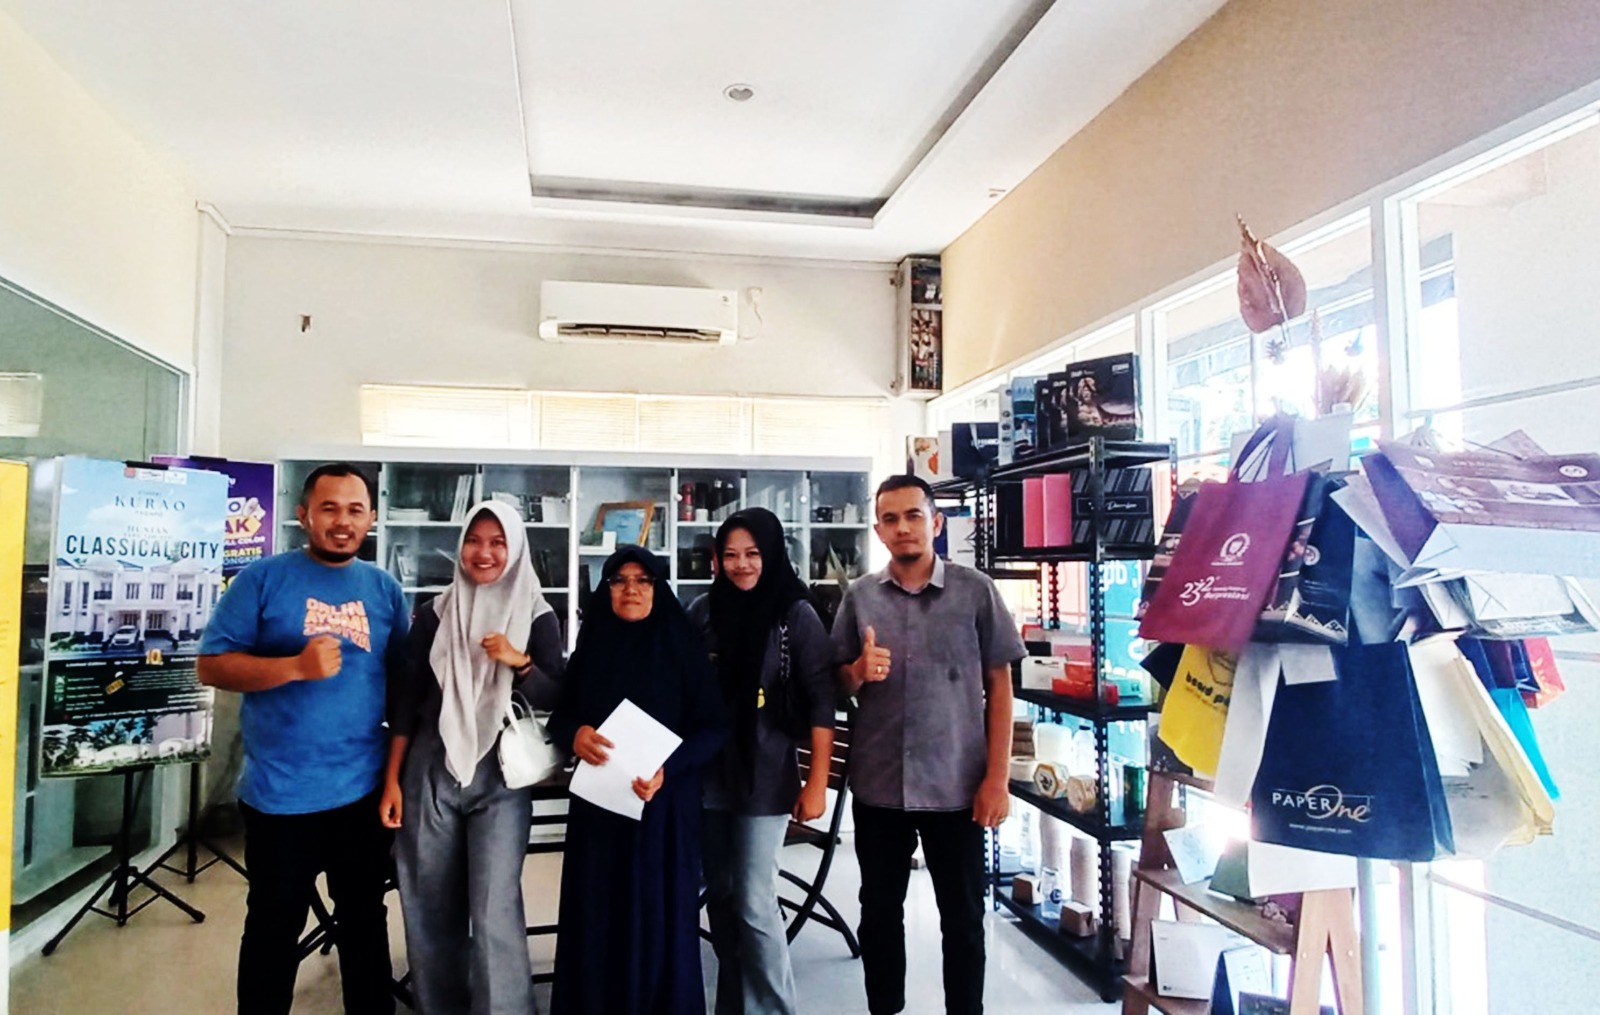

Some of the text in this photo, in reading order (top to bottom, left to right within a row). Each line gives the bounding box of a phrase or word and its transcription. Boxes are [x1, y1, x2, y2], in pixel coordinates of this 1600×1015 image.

[115, 495, 186, 512] KURAO
[66, 534, 219, 560] CLASSICAL CITY
